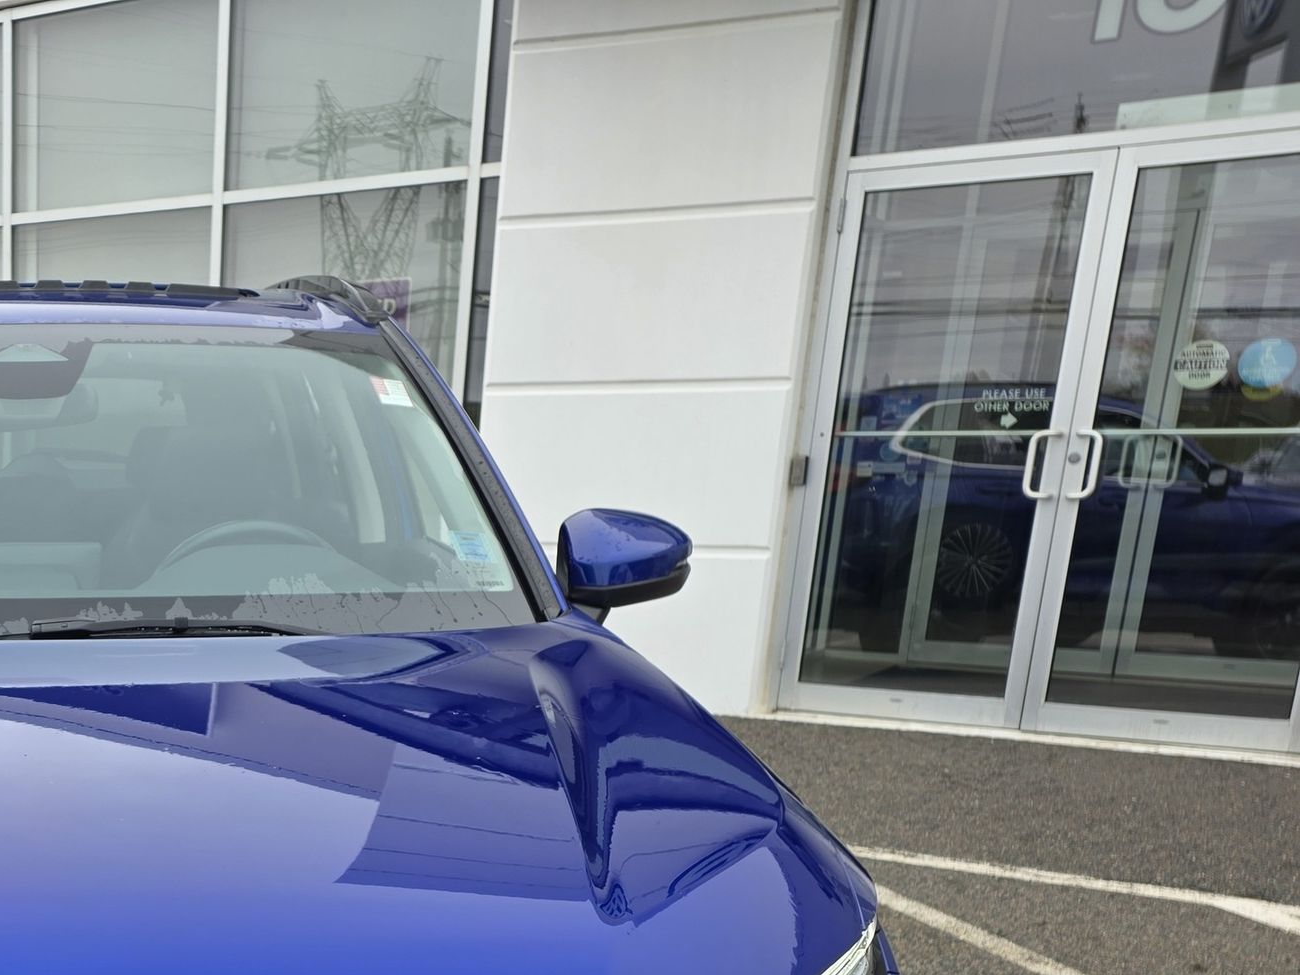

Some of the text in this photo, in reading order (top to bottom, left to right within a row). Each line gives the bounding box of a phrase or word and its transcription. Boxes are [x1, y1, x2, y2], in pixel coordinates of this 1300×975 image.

[1175, 359, 1228, 371] CAUTION
[982, 387, 1047, 400] PLEASE USE
[974, 400, 1050, 413] OTHER DOOR
